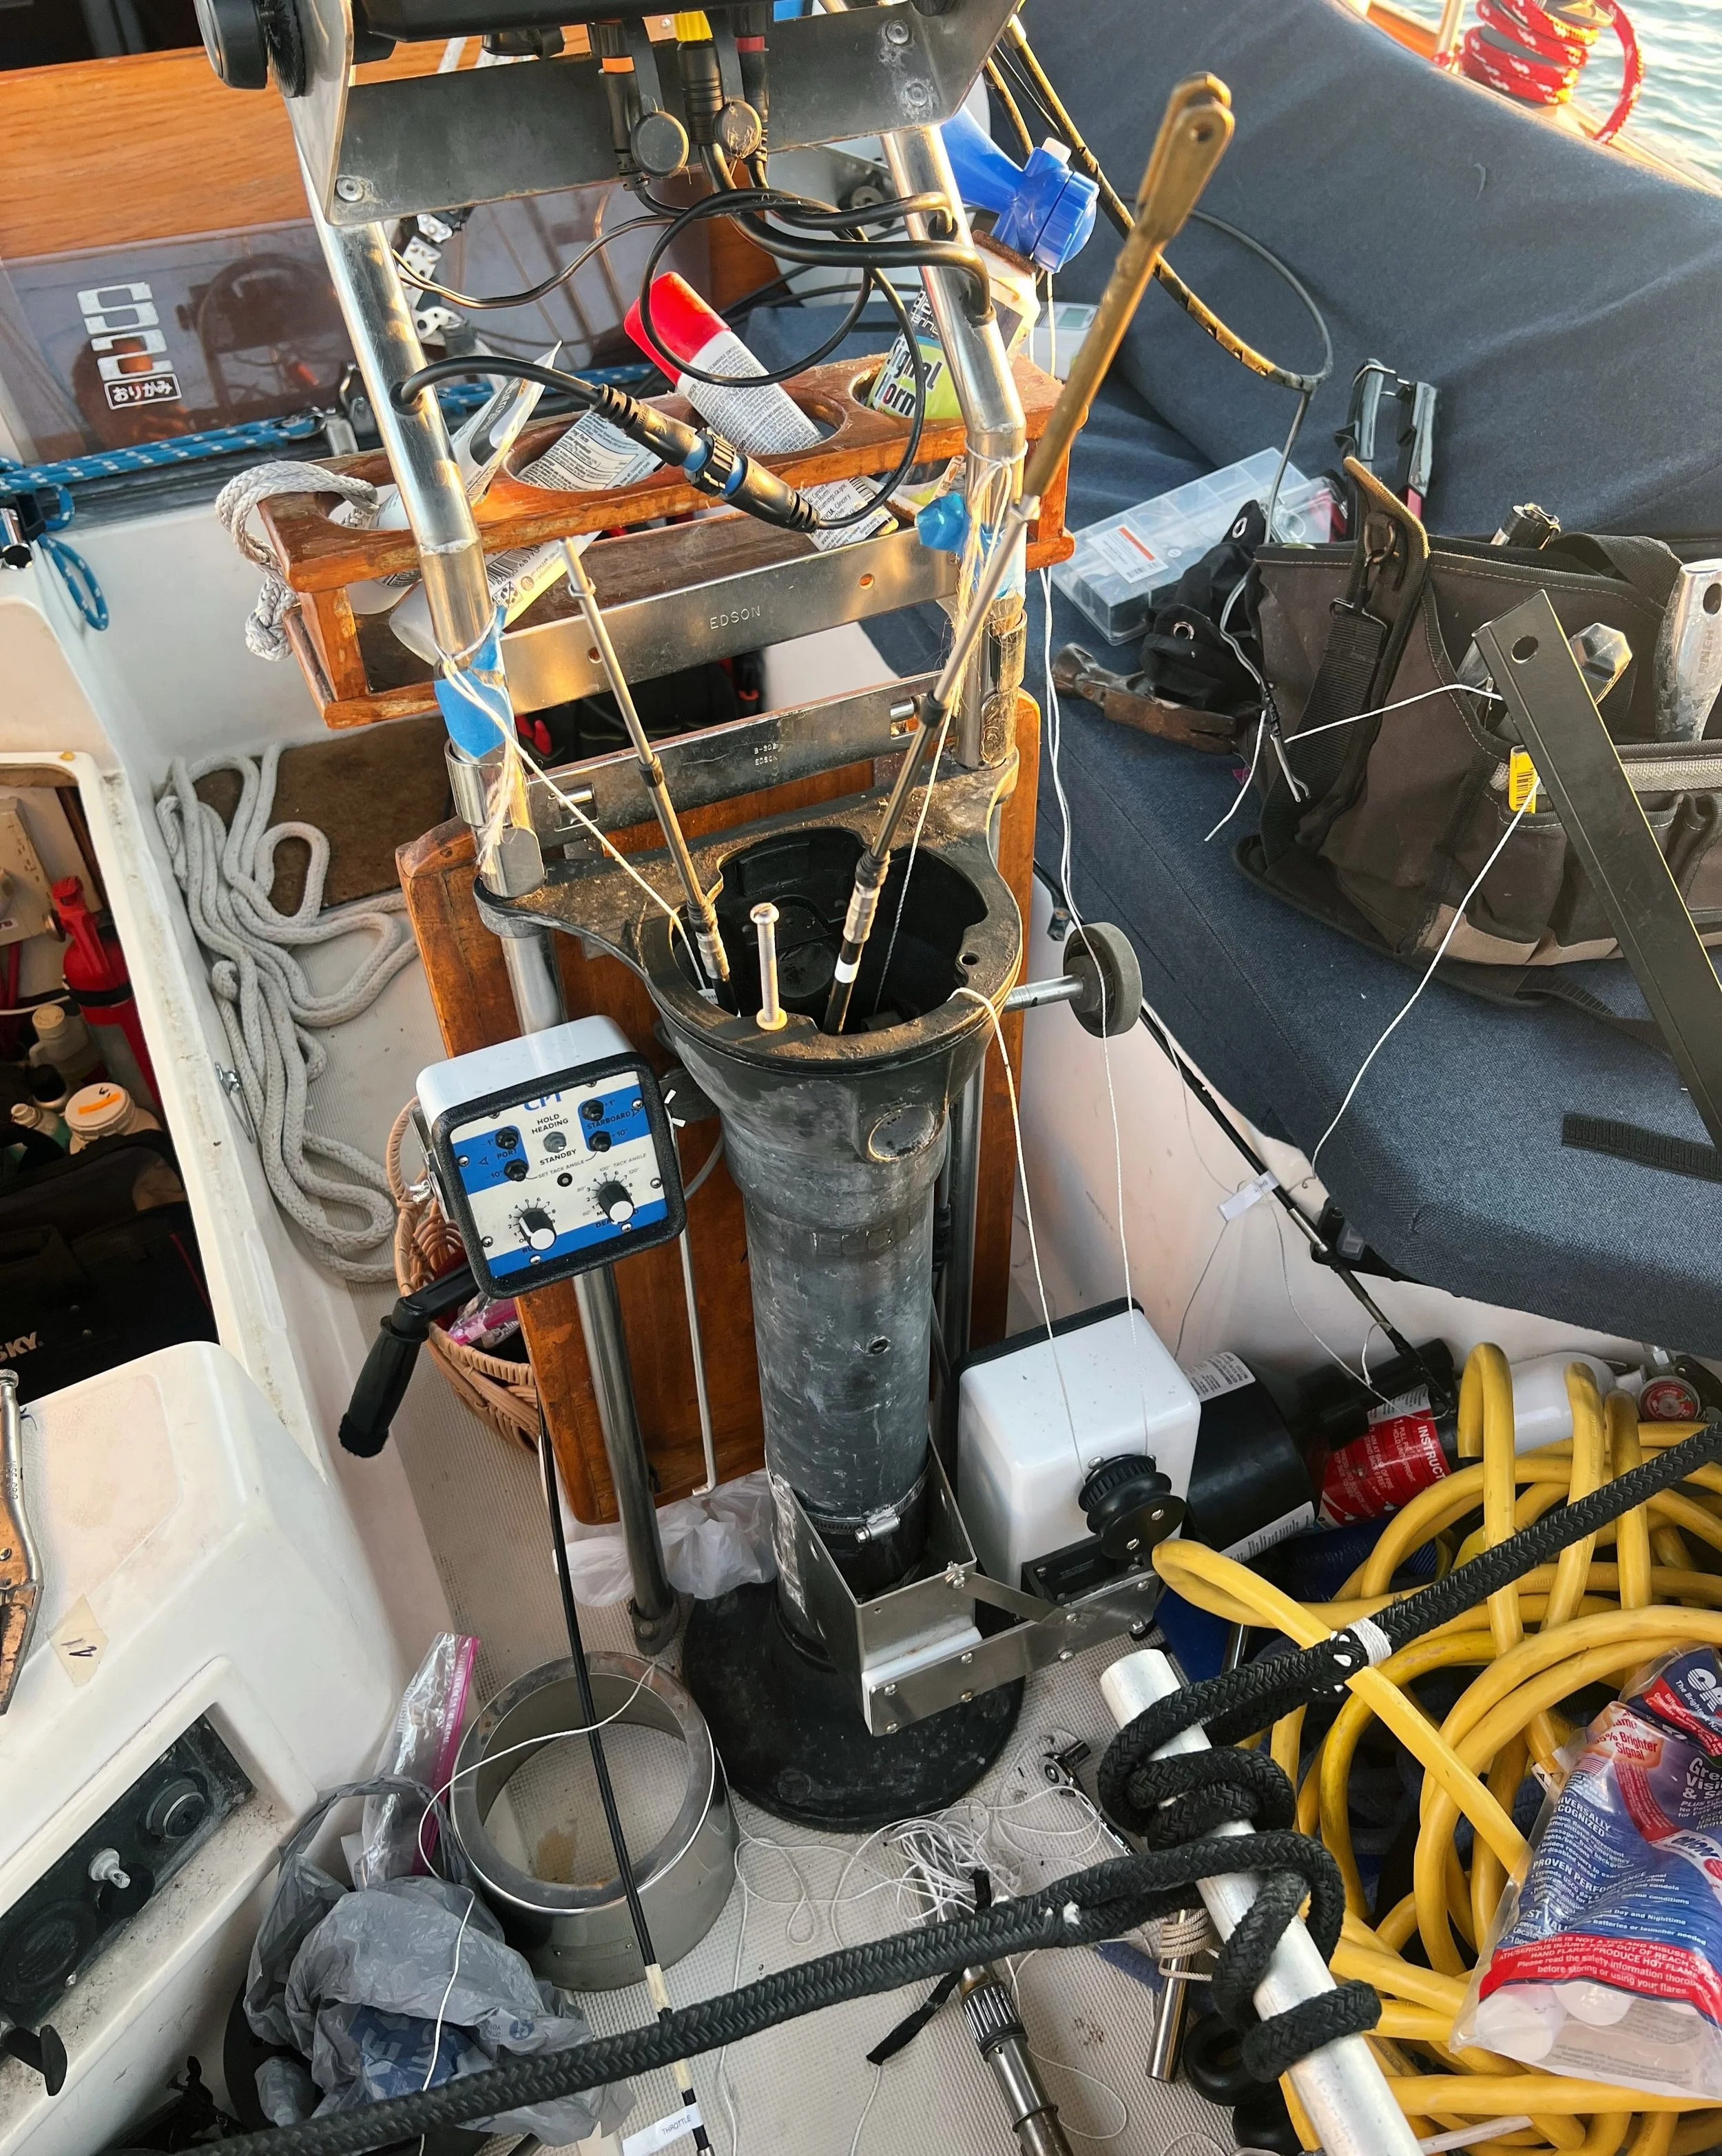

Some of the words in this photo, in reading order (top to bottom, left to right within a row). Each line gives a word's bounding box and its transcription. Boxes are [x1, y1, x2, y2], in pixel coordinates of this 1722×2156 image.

[112, 380, 174, 402] おりがみ
[875, 371, 916, 417] Horn
[709, 605, 760, 630] EDSON
[531, 1118, 569, 1134] HEADING
[537, 1113, 560, 1125] HOLD
[587, 1111, 632, 1130] STARBOARD
[497, 1148, 517, 1160] PORT
[540, 1148, 577, 1165] STANDBY
[628, 1152, 647, 1163] ANGLE
[550, 1167, 565, 1176] TACK
[566, 1159, 585, 1170] ANGLE
[1393, 1428, 1402, 1444] HOLD
[1654, 1692, 1675, 1716] Consider
[1665, 1693, 1686, 1718] Different
[1675, 1679, 1687, 1692] The
[1685, 1692, 1710, 1722] Brightest
[1615, 1742, 1645, 1761] Signal
[1620, 1731, 1658, 1754] Brighter
[1682, 1787, 1697, 1800] &
[1553, 1804, 1605, 1838] COGNIZED
[1557, 1796, 1611, 1832] IVERSALLY
[1579, 1840, 1593, 1856] from
[1591, 1835, 1624, 1858] movement
[1533, 1858, 1573, 1875] PROVEN
[1548, 1847, 1576, 1863] disabled
[1577, 1860, 1597, 1880] vessel
[1566, 1845, 1592, 1869] rescuers
[1579, 1891, 1593, 1900] day
[1649, 1883, 1679, 1891] candela
[1575, 1895, 1586, 1904] for
[1648, 1895, 1690, 1905] conditions
[1614, 1909, 1629, 1917] Day
[1630, 1911, 1646, 1919] and
[1648, 1914, 1686, 1926] Nighttime
[1593, 1918, 1628, 1929] batteries
[1640, 1926, 1675, 1936] launcher
[1677, 1932, 1707, 1947] needed
[1531, 1951, 1555, 1959] HAND
[1593, 1945, 1641, 1963] PRODUCE
[1643, 1958, 1663, 1969] HOT
[1617, 1945, 1637, 1953] OUT
[1639, 1948, 1654, 1956] OF
[1655, 1952, 1688, 1967] REACH
[1649, 1945, 1687, 1959] MISUSE
[1517, 1959, 1544, 1968] Please
[1545, 1955, 1564, 1964] read
[1566, 1953, 1580, 1962] the
[1581, 1953, 1609, 1968] safety
[1610, 1959, 1663, 1980] information
[1537, 1965, 1566, 1973] before
[1568, 1964, 1598, 1975] storing
[1610, 1971, 1636, 1987] using
[1637, 1978, 1658, 1989] your
[661, 2115, 692, 2136] THROTTLE
